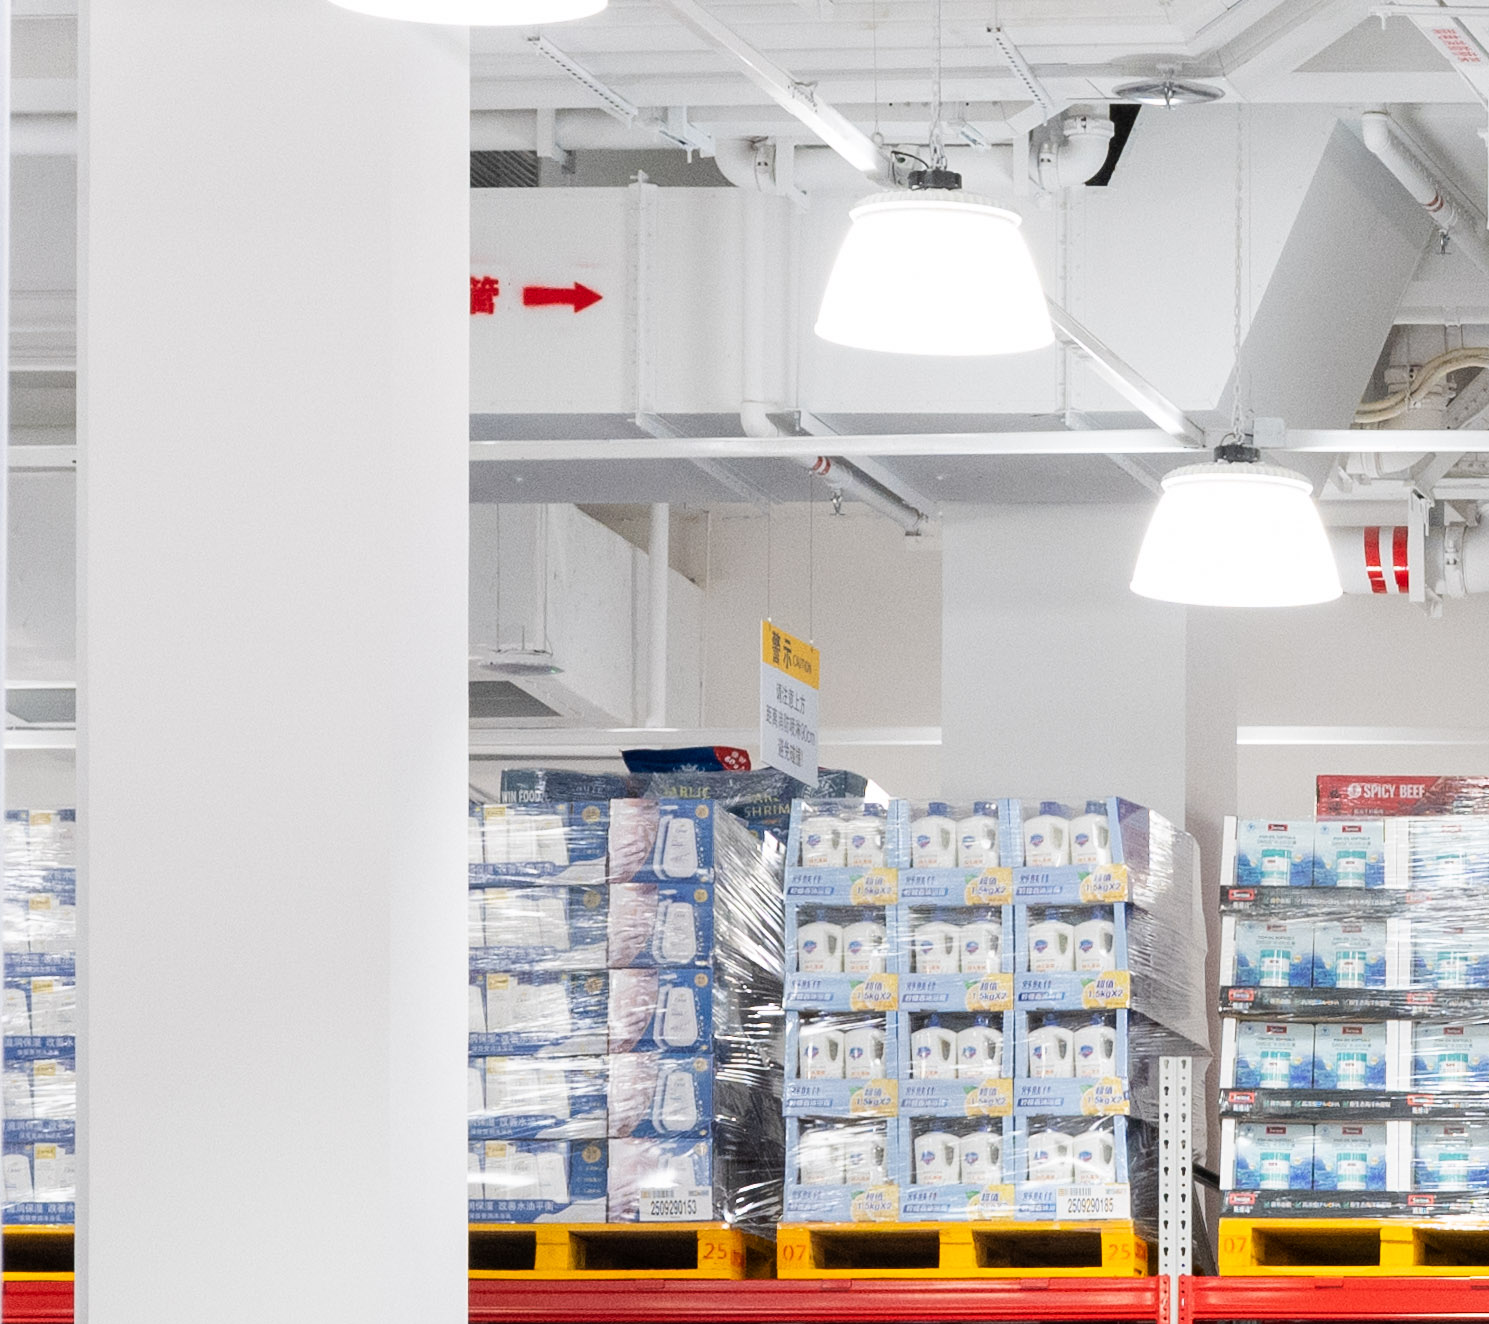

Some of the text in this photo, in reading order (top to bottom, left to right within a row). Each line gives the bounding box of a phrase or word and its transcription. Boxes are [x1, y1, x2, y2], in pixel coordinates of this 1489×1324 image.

[771, 631, 793, 669] 警示
[1362, 784, 1425, 797] SPICY BEEF
[650, 1200, 697, 1216] 2509290153
